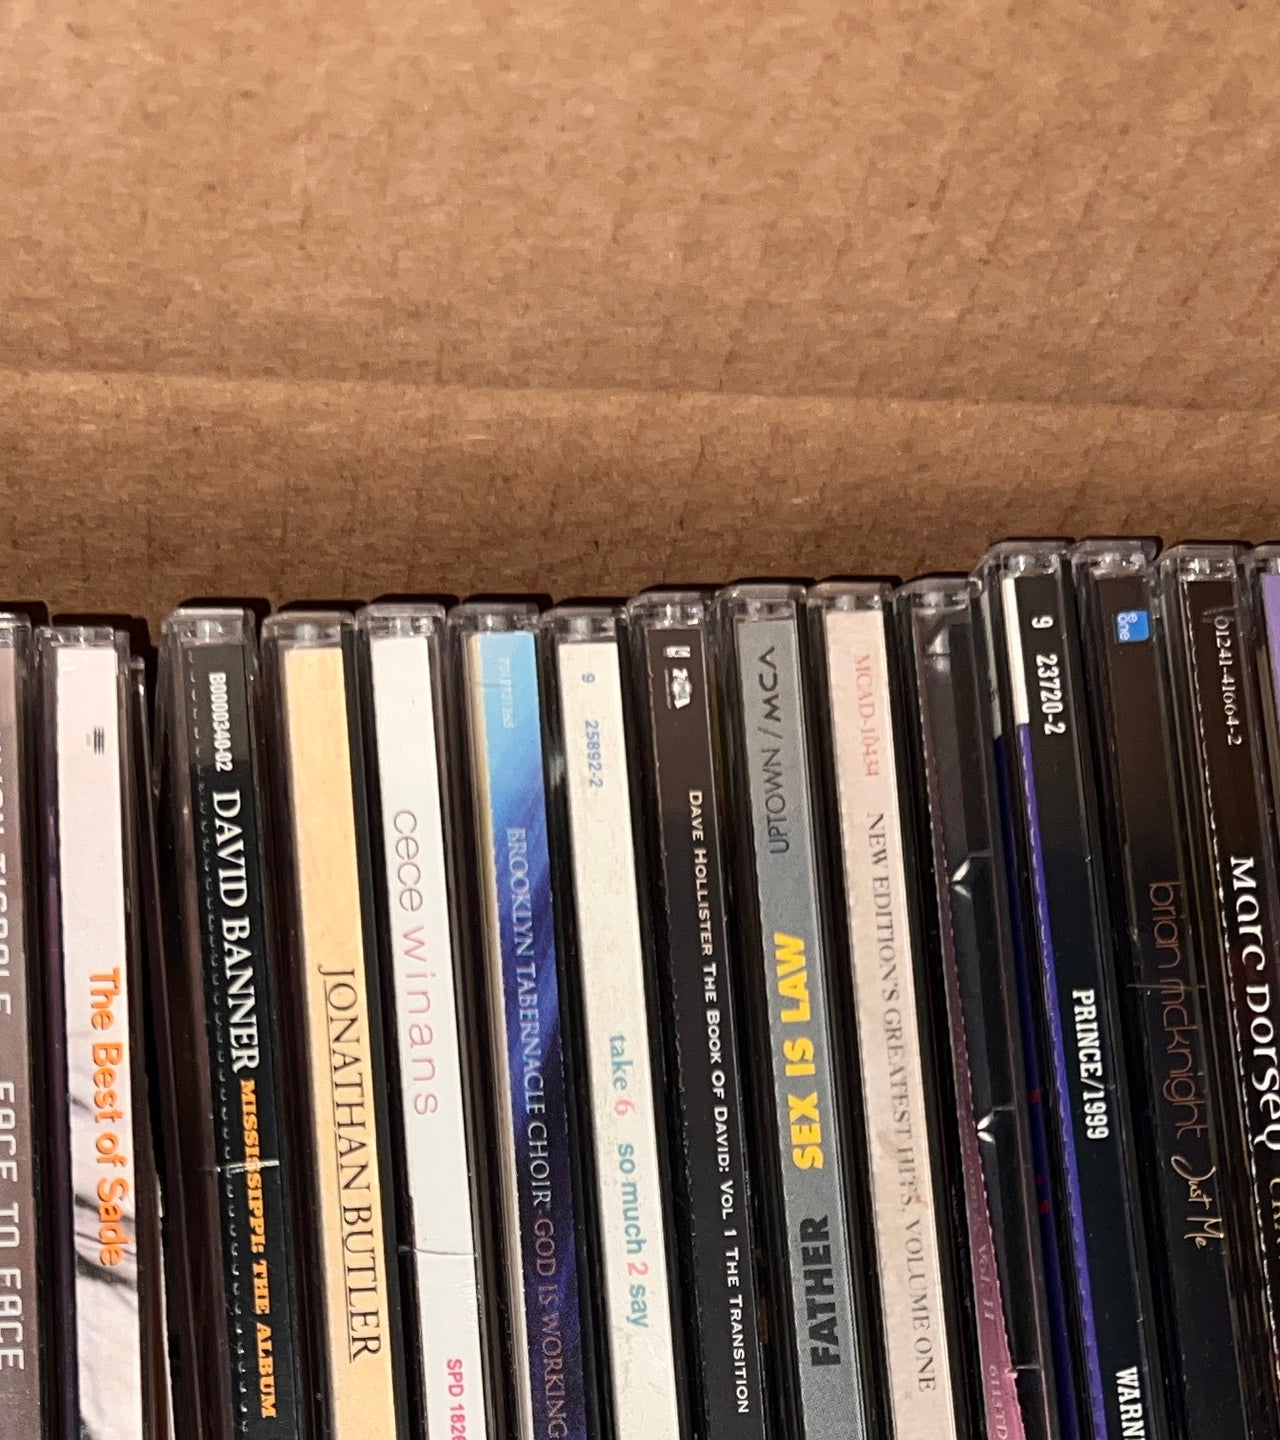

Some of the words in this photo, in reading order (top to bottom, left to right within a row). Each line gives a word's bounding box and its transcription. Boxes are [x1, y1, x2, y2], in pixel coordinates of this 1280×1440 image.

[1036, 654, 1064, 735] 23720-2
[211, 790, 250, 907] DAVID
[761, 748, 788, 854] UPTOWN
[866, 812, 886, 866] NEW
[391, 810, 424, 912] cece
[505, 828, 534, 956] BROOKLYN
[774, 934, 809, 1020] LAW
[1146, 881, 1187, 969] brian
[221, 918, 259, 1072] BANNER
[402, 925, 441, 1116] winans
[513, 963, 545, 1114] TABERNACLE
[91, 1042, 124, 1123] Best
[317, 966, 371, 1191] JONATHAN
[607, 1034, 631, 1091] take
[883, 1008, 910, 1137] GREATEST
[1072, 989, 1108, 1140] PRINCE/1999
[787, 1093, 823, 1169] SEX
[97, 1178, 129, 1265] Sade
[618, 1181, 647, 1254] much
[341, 1206, 382, 1362] BUTLER
[799, 1217, 841, 1365] FATHER
[902, 1221, 932, 1330] VOLUME
[254, 1321, 276, 1418] ALBUM
[444, 1358, 464, 1397] SPD
[539, 1312, 567, 1439] WORKING
[914, 1337, 936, 1392] ONE
